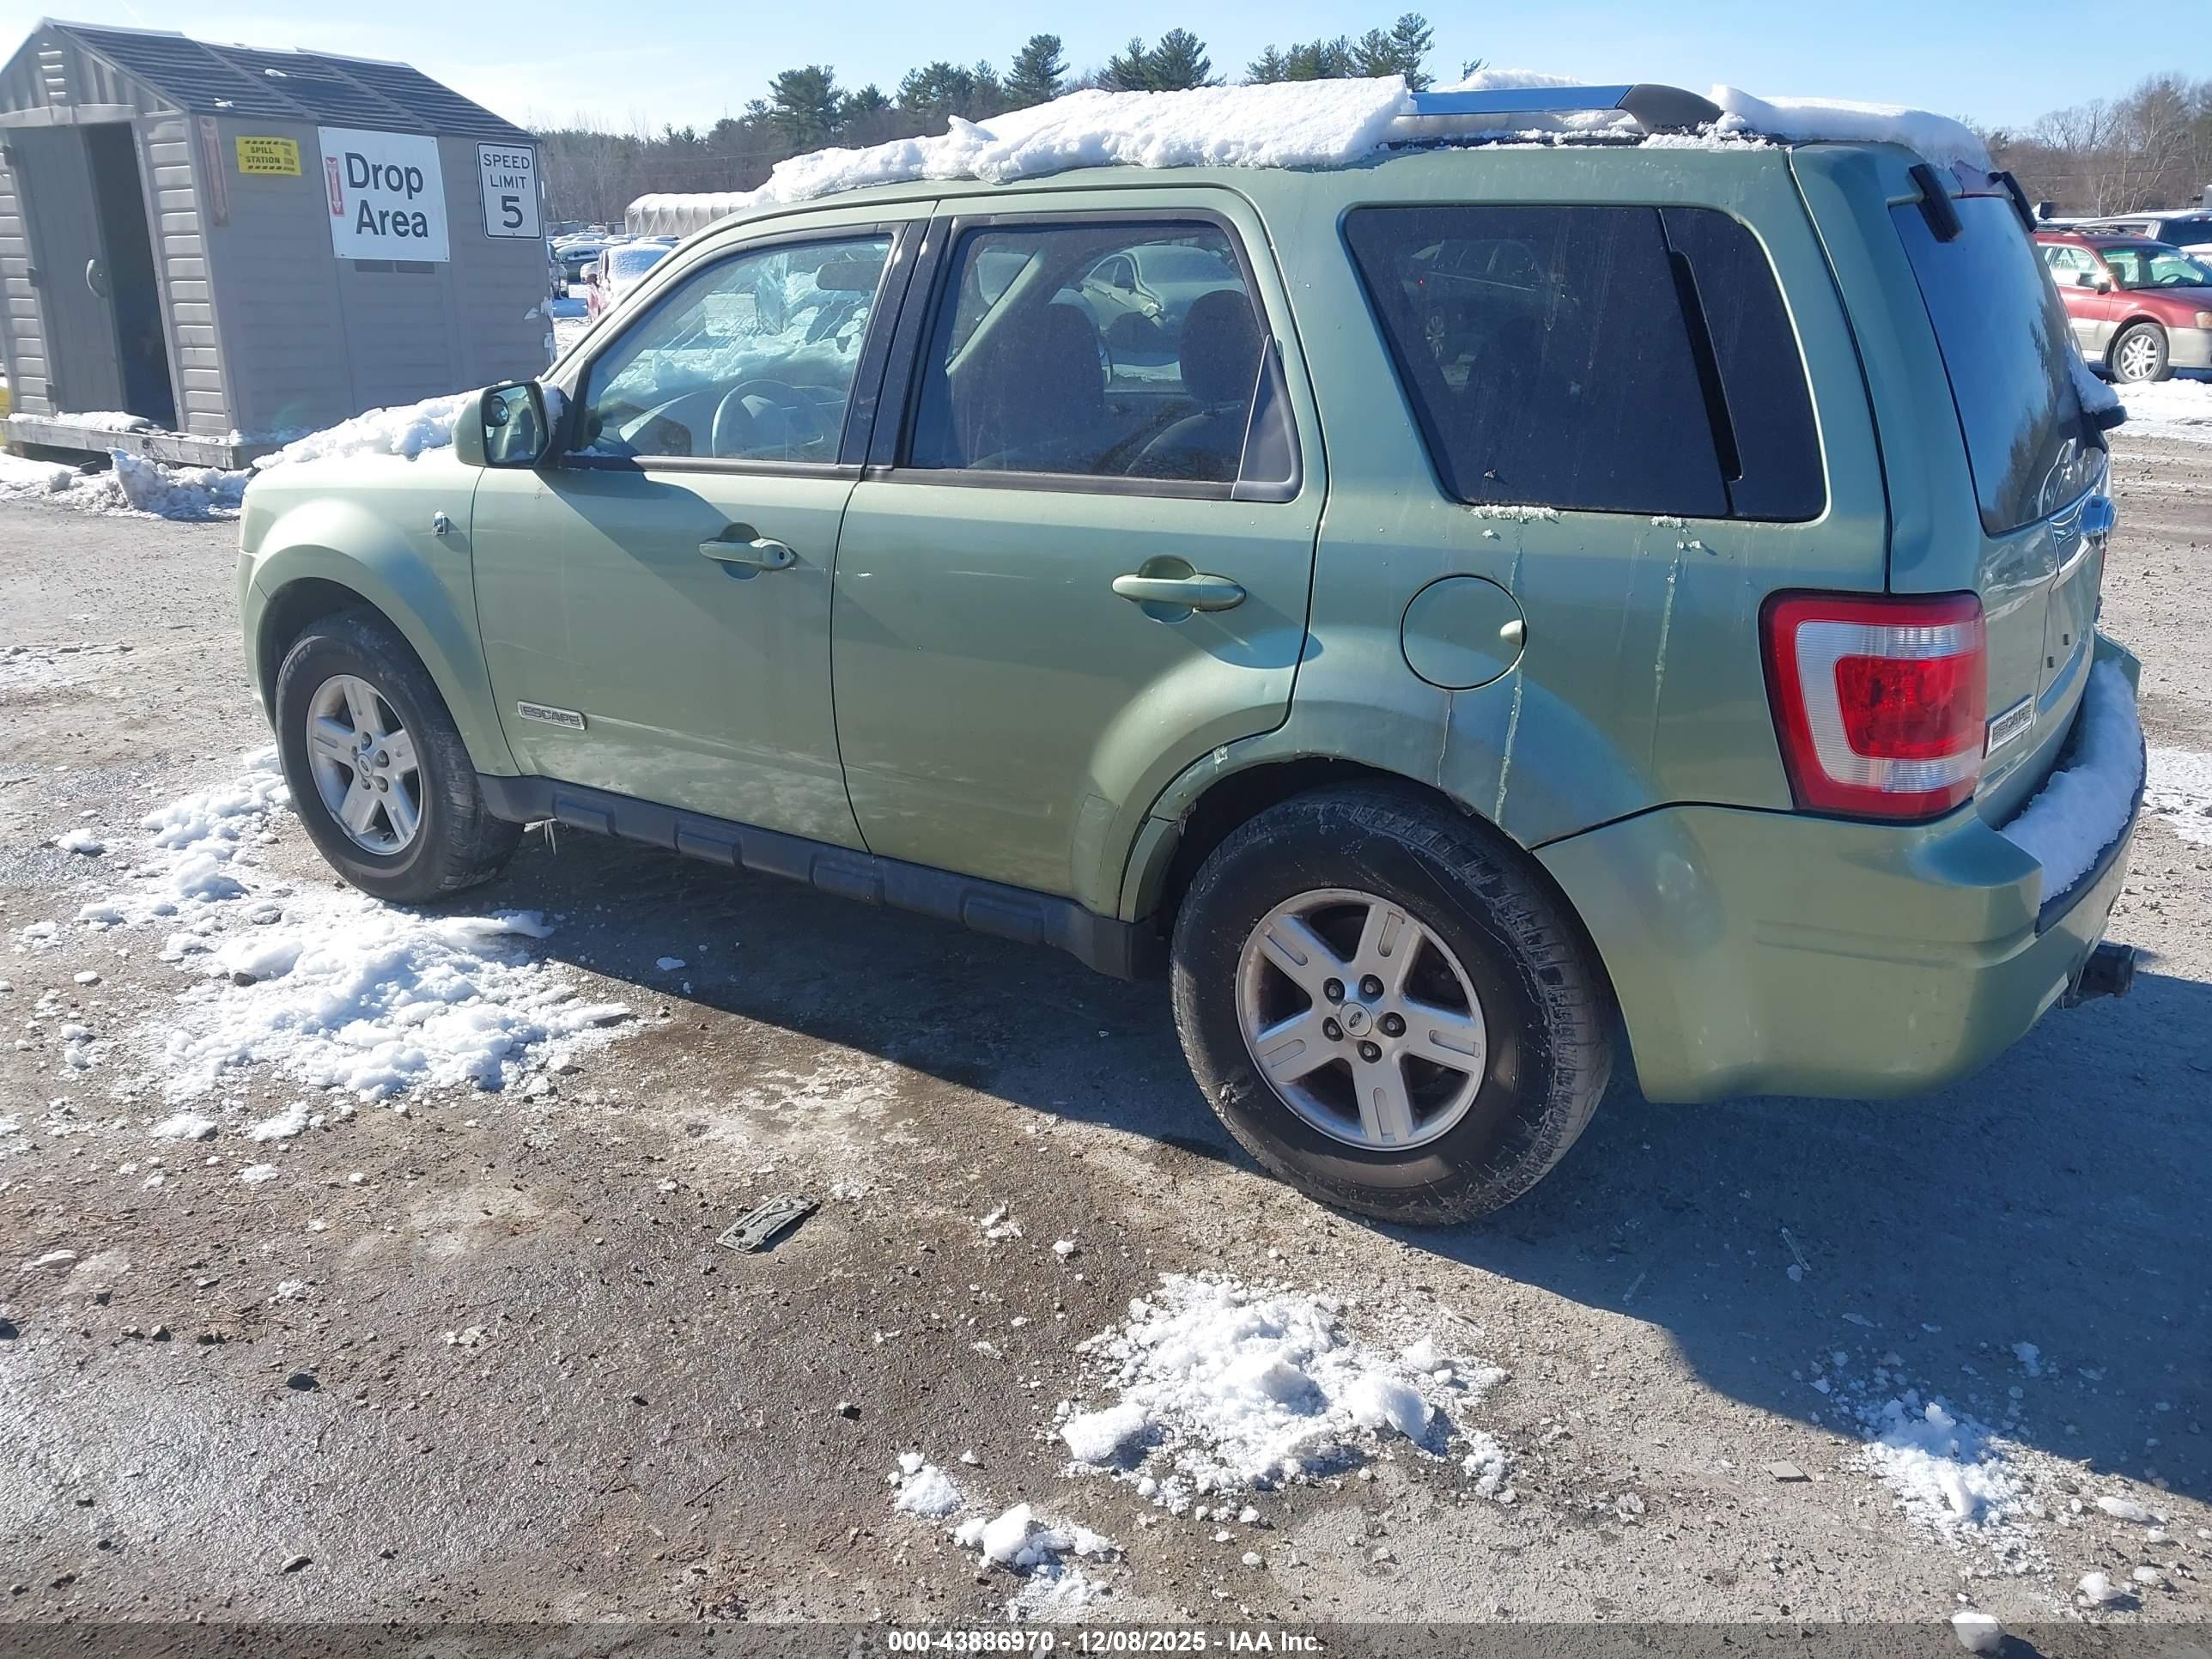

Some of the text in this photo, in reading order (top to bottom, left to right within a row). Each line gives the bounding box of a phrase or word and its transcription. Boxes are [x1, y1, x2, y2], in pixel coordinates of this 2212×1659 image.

[246, 155, 281, 164] STATION
[483, 154, 530, 169] SPEED
[345, 152, 423, 199] Drop
[489, 173, 526, 189] LIMIT
[356, 199, 428, 238] Area
[501, 195, 523, 228] 5
[522, 706, 580, 726] ESCAPE
